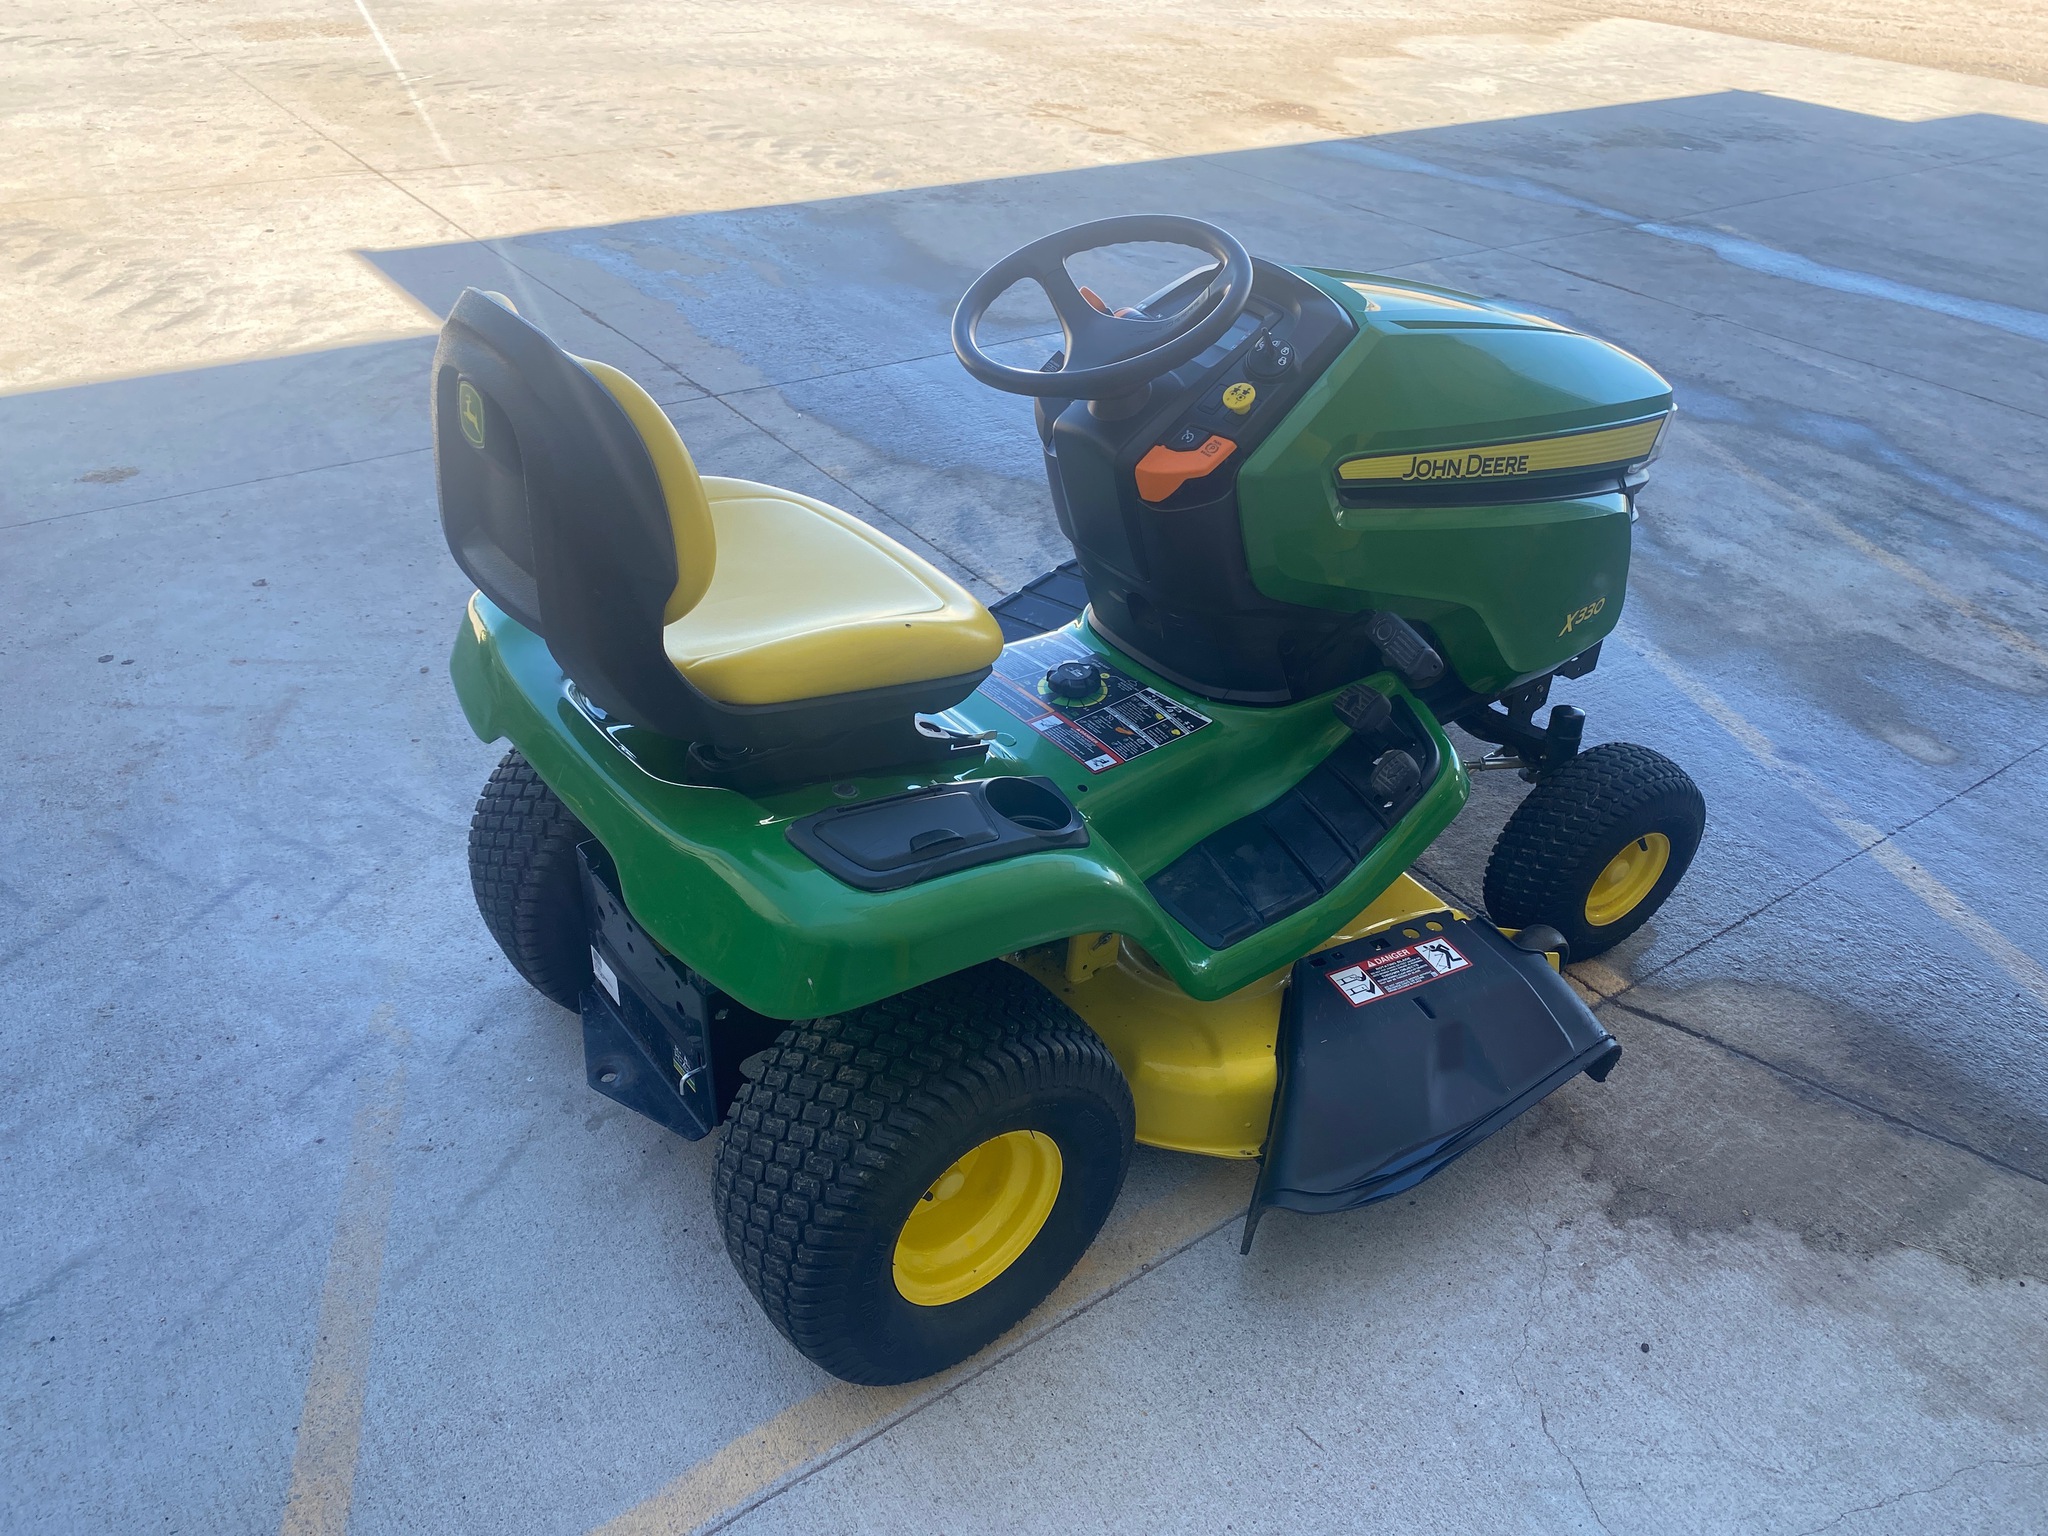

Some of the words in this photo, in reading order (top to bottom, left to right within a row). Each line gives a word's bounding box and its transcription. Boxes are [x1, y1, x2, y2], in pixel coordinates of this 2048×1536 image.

[1402, 456, 1463, 480] JOHN
[1465, 454, 1530, 477] DEERE
[1558, 597, 1606, 637] X330
[1374, 948, 1411, 965] DANGER
